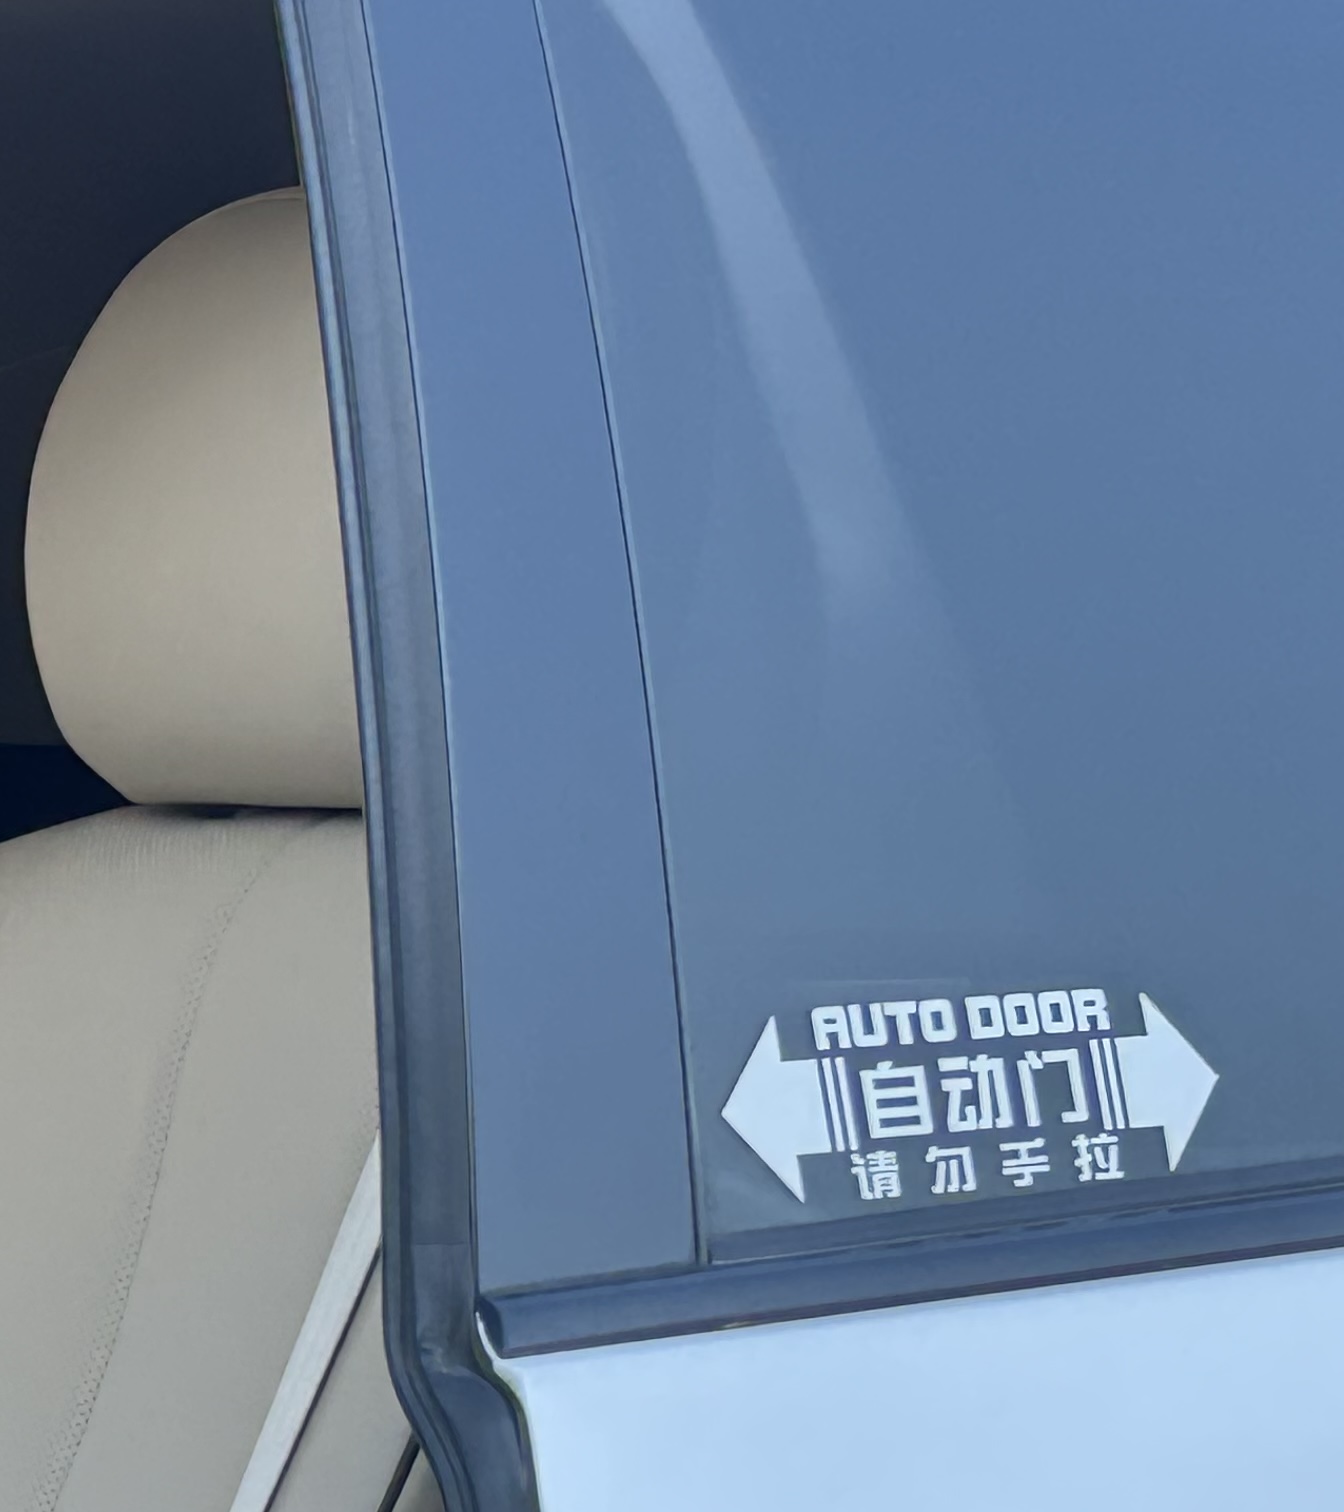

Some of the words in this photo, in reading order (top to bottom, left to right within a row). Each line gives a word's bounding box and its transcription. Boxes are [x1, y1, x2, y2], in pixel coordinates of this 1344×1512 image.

[811, 998, 958, 1051] AUTO
[964, 988, 1111, 1040] DOOR
[858, 1047, 1090, 1139] 自动门
[850, 1132, 1125, 1200] 请勿手拉
